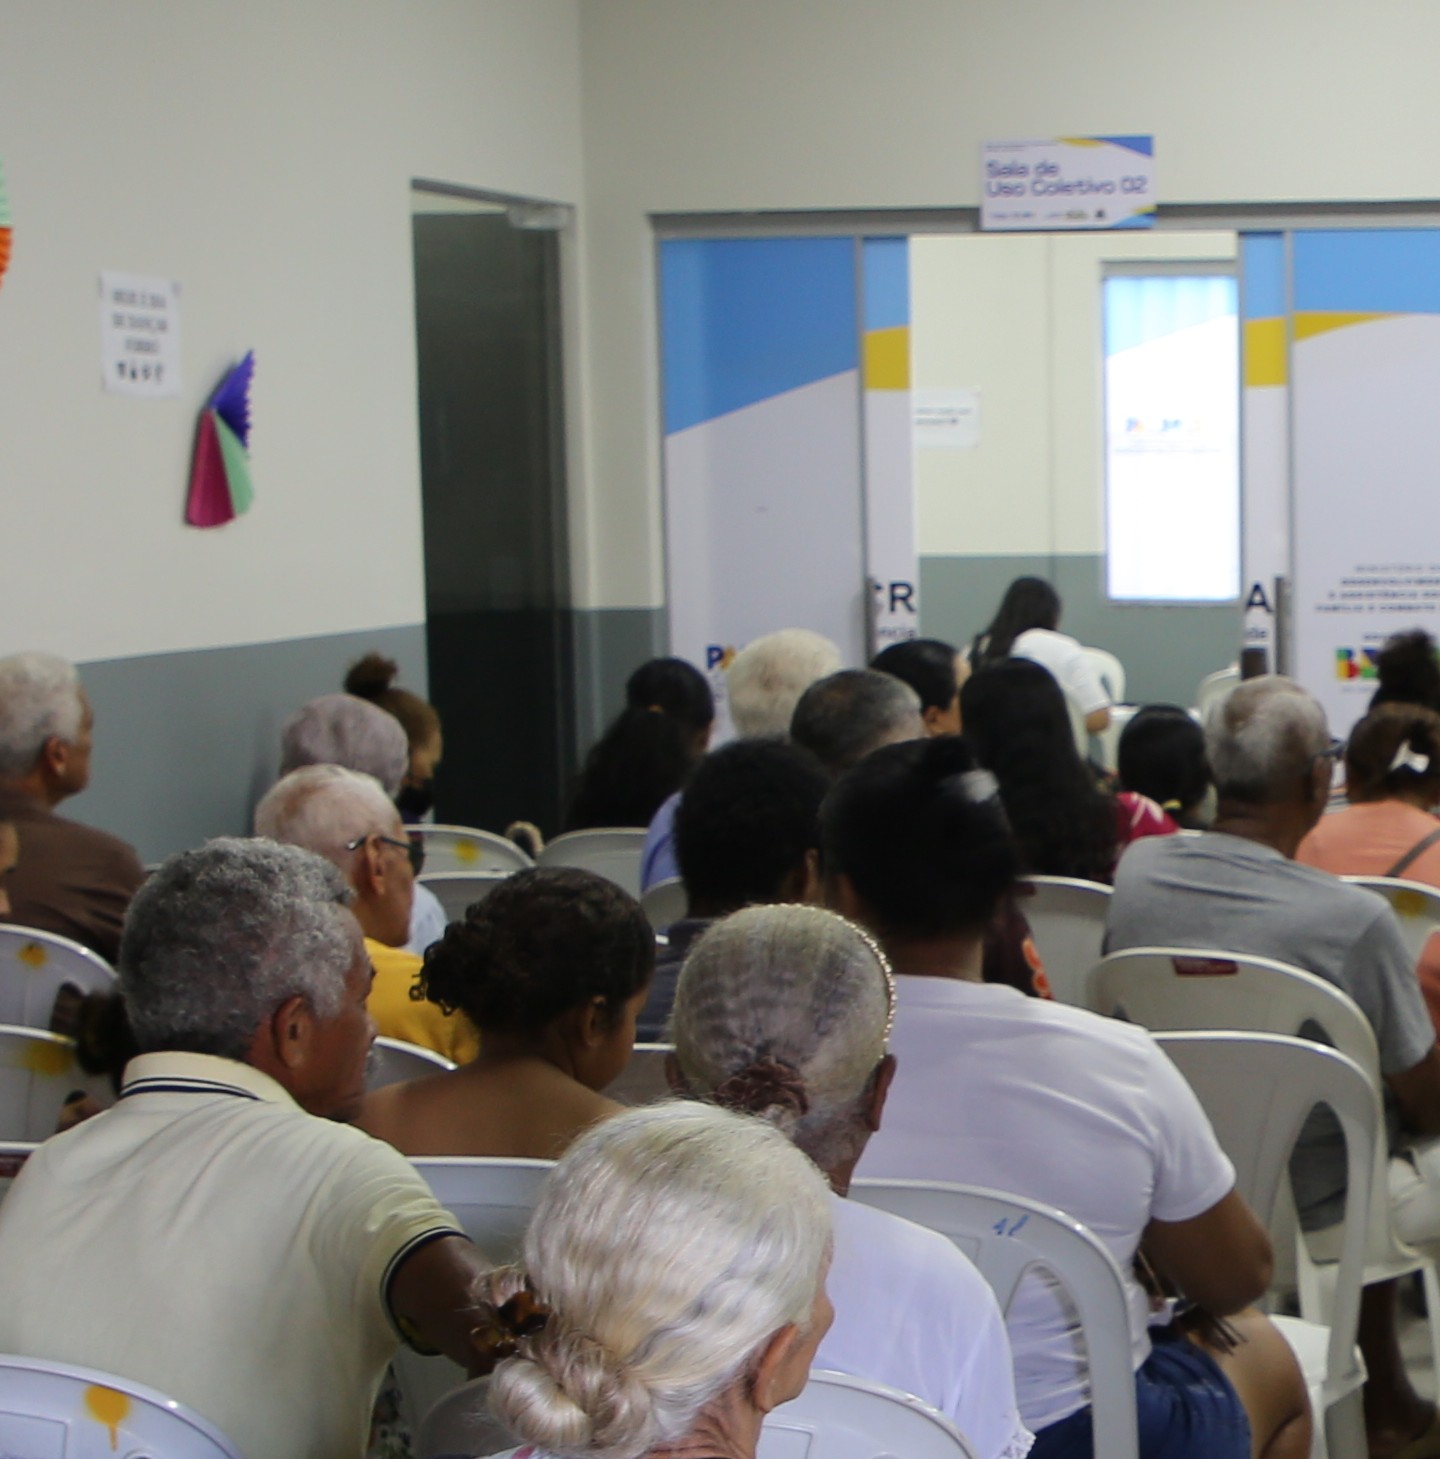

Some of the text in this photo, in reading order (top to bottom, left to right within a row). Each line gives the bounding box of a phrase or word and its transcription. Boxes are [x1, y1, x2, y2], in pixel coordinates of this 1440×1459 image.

[987, 159, 1058, 178] Sala de
[987, 180, 1025, 197] Uso
[1032, 179, 1116, 196] Coletivo
